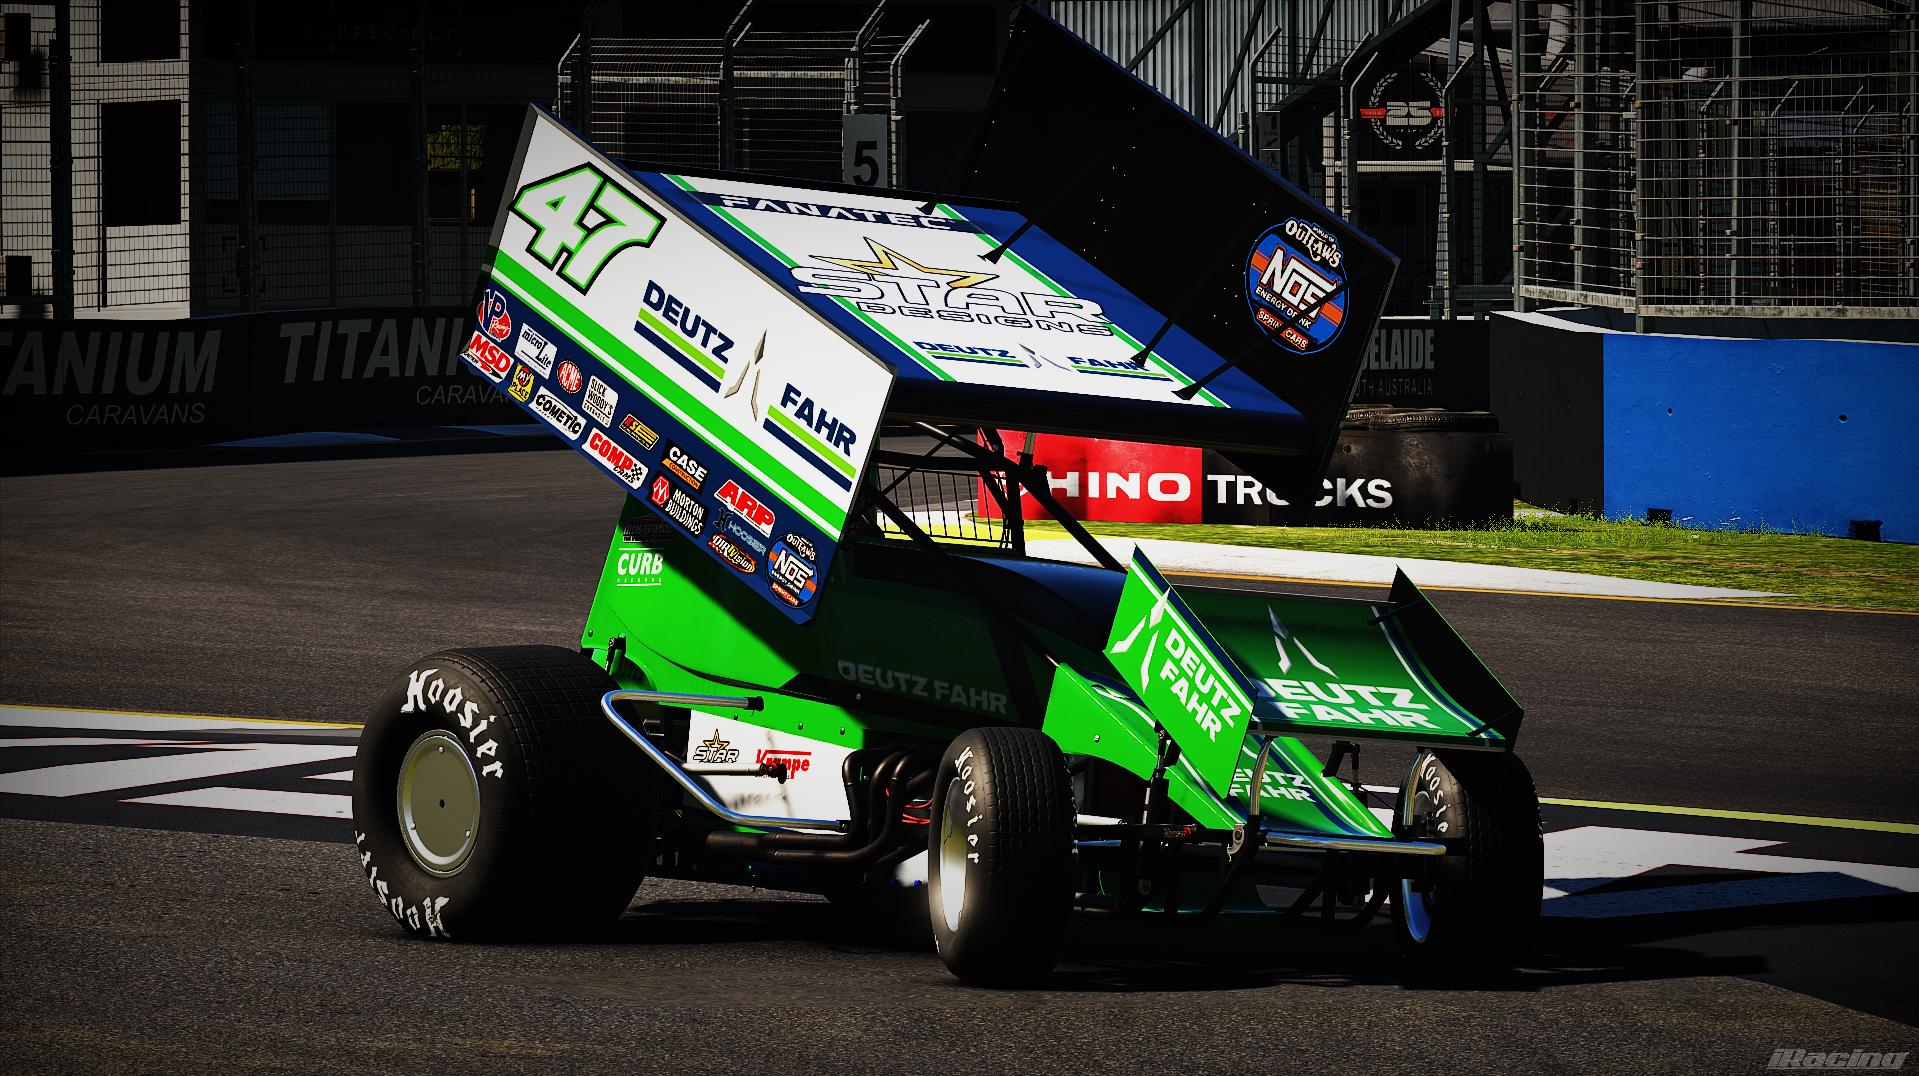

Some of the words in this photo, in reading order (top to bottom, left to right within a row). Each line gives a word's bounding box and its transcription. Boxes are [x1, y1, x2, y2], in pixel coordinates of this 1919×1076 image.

[853, 140, 879, 186] 5
[509, 162, 667, 295] 47
[720, 195, 953, 230] FANATEC
[1285, 219, 1342, 268] OUTLAWS
[790, 265, 1112, 325] STAR
[1259, 245, 1338, 321] NOS
[857, 302, 1118, 337] DESIGNS
[1256, 286, 1287, 313] ENERGY
[1286, 306, 1312, 329] DRNK
[1257, 311, 1283, 330] SPRIN
[1285, 329, 1308, 349] CARS
[1361, 328, 1435, 370] ELAIDE
[0, 330, 223, 396] ANIUM
[279, 317, 481, 386] TITANI
[469, 333, 511, 373] MSD
[641, 280, 735, 364] DEUTZ
[780, 383, 857, 457] FAHR
[913, 341, 1018, 360] DEUTZ
[1066, 357, 1151, 372] FAHR
[590, 378, 608, 398] SLICK
[65, 402, 207, 426] CARAVANS
[535, 394, 582, 435] COMETIC
[589, 432, 634, 471] COMP
[669, 446, 708, 481] CASE
[613, 465, 636, 484] CAMS
[1047, 472, 1192, 502] HINO
[665, 499, 704, 535] BUILDINGS
[672, 488, 705, 520] MORTON
[718, 481, 775, 526] ARP
[617, 552, 664, 576] CURB
[773, 549, 814, 589] NOS
[836, 659, 929, 698] DEUTZ
[933, 680, 1008, 716] FAHR
[1163, 628, 1243, 728] DEUTZ
[1160, 662, 1223, 743] FAHR
[1270, 700, 1442, 730] FAHR
[400, 668, 504, 779] Hoosier
[692, 745, 740, 763] STAR
[1233, 768, 1313, 789] EUTZ
[955, 746, 984, 865] Hoosier
